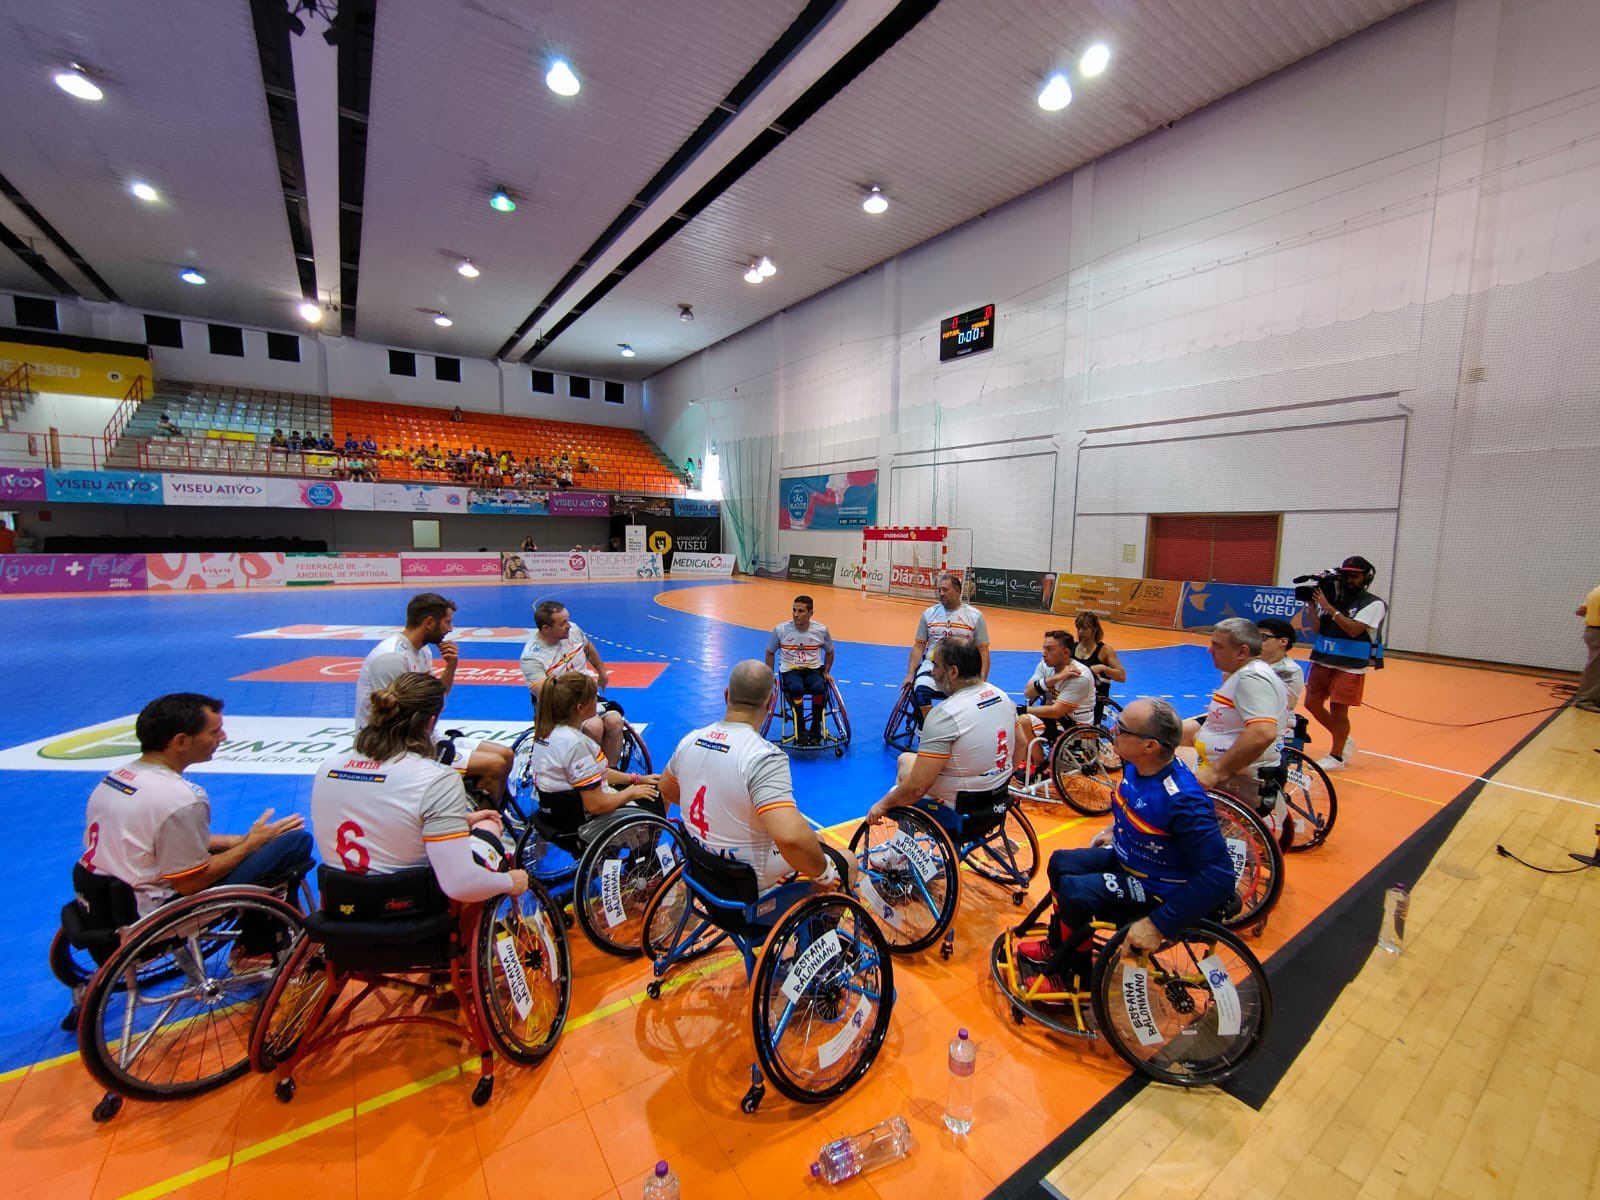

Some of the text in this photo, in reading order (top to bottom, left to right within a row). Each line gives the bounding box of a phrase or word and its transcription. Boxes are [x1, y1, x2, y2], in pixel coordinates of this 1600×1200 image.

[56, 478, 152, 492] VISEU ATIVO
[171, 483, 256, 495] VISEU ATIVO
[554, 498, 603, 508] VISEU ATIVO
[676, 541, 707, 551] VISEU
[672, 557, 712, 569] MEDICAL
[349, 569, 390, 578] PORTUGAL
[1252, 603, 1296, 617] VISEU
[1323, 639, 1335, 651] TV
[690, 785, 710, 840] 4
[336, 820, 371, 876] 6
